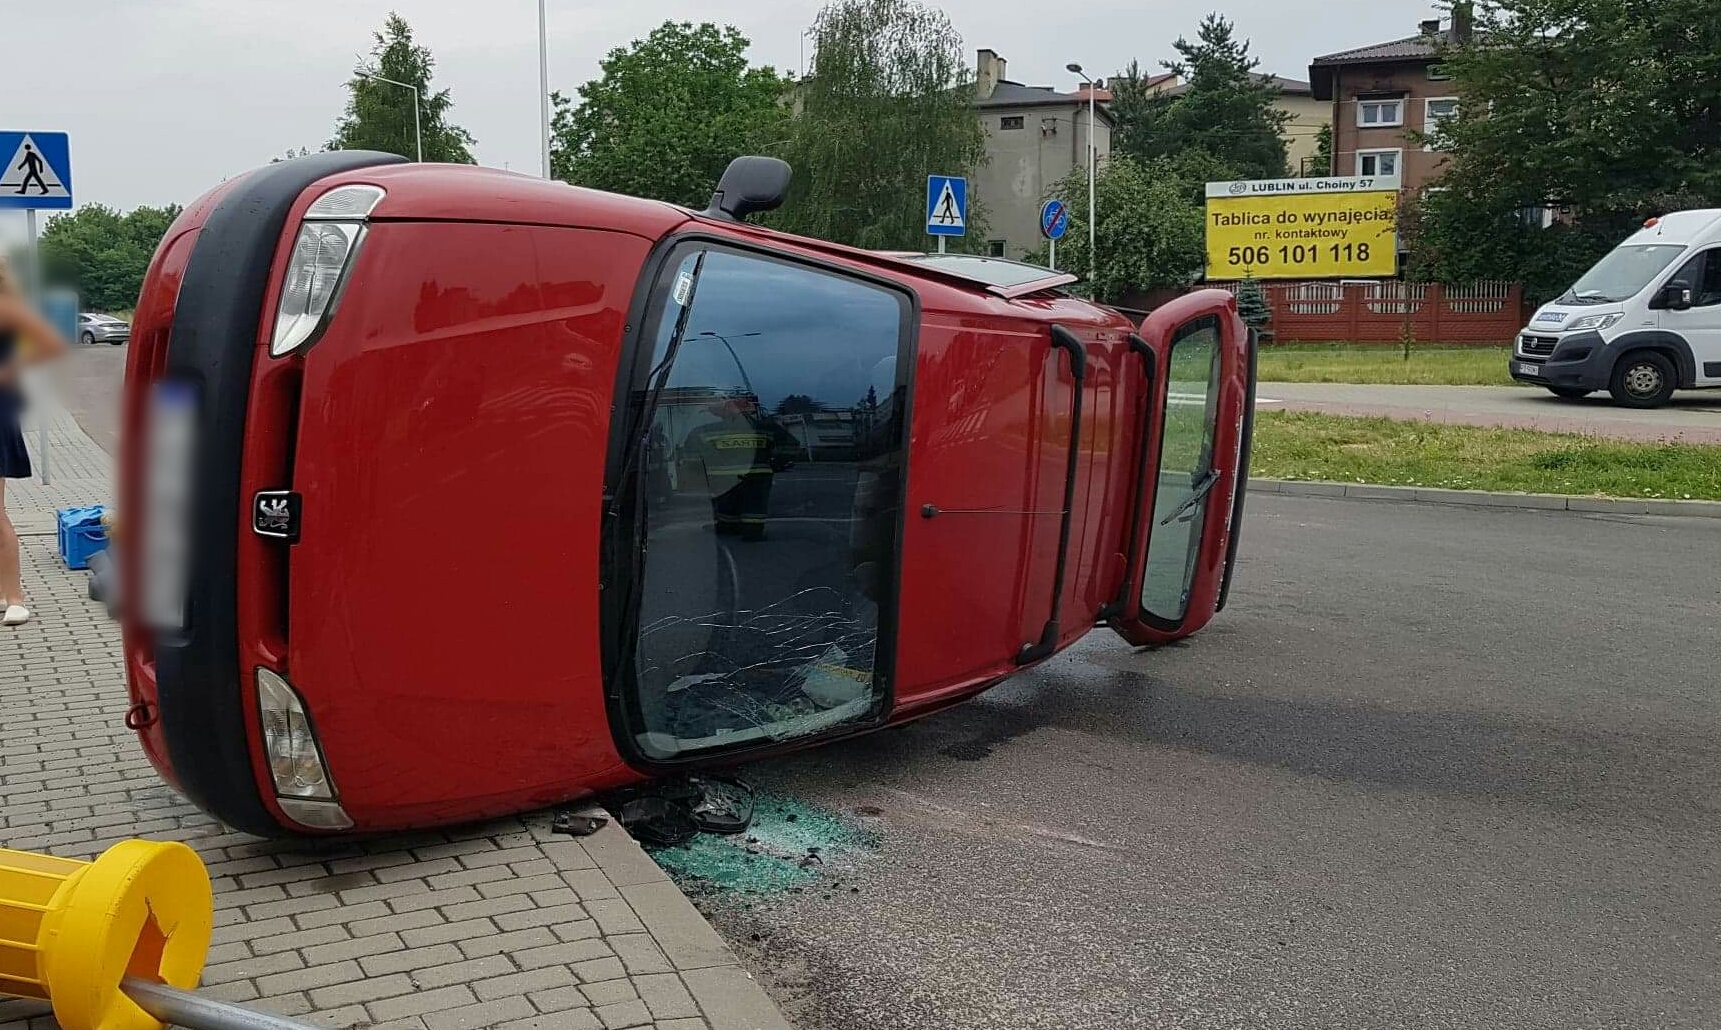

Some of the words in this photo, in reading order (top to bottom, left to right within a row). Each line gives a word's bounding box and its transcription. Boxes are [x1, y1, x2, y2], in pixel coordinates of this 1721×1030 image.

[1252, 182, 1295, 192] LUBLIN
[1299, 180, 1312, 190] ul.
[1316, 179, 1356, 190] Choiny
[1359, 179, 1374, 188] 57
[1212, 212, 1271, 226] Tablica
[1276, 210, 1298, 224] do
[1303, 208, 1389, 225] wynajęcia
[1254, 230, 1270, 240] nr.
[1275, 228, 1349, 240] kontaktowy
[1228, 245, 1270, 266] 506
[1278, 244, 1319, 264] 101
[1329, 242, 1370, 263] 118
